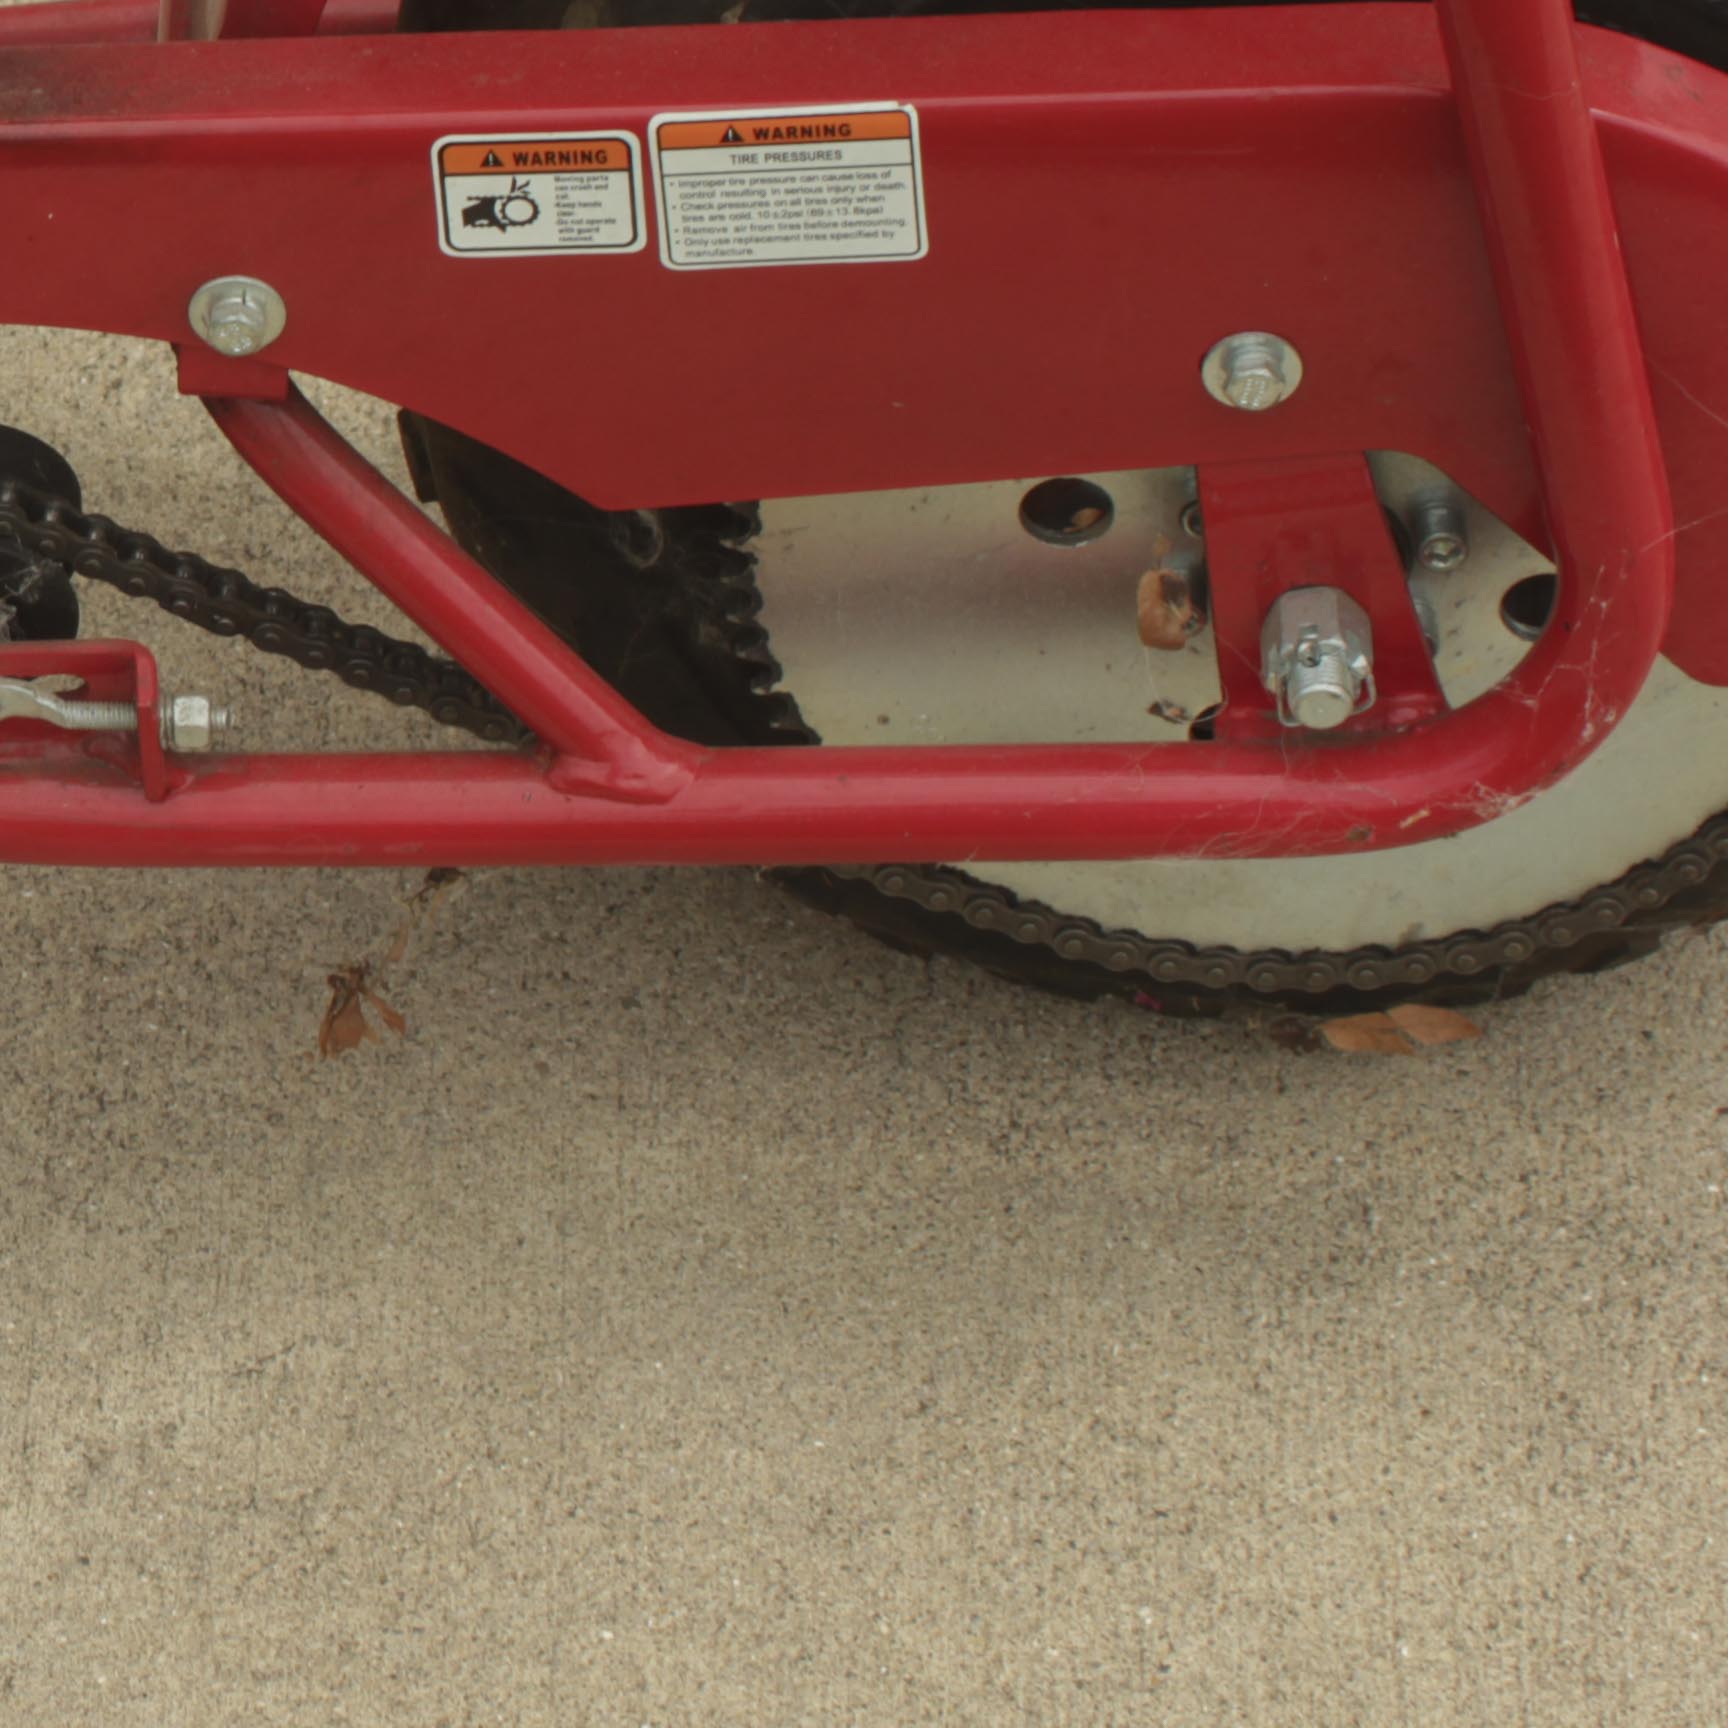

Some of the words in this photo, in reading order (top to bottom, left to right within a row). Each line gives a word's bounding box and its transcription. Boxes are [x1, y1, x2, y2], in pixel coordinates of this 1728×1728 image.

[752, 123, 852, 141] WARNING
[512, 149, 608, 166] WARNING
[730, 153, 759, 165] TIRE
[763, 149, 843, 163] PRESSURES
[678, 179, 726, 190] Improper
[749, 175, 796, 187] pressure
[679, 190, 717, 200] control
[720, 188, 766, 199] resulting
[680, 201, 714, 211] Check
[716, 199, 771, 211] pressures
[683, 224, 729, 234] Remove
